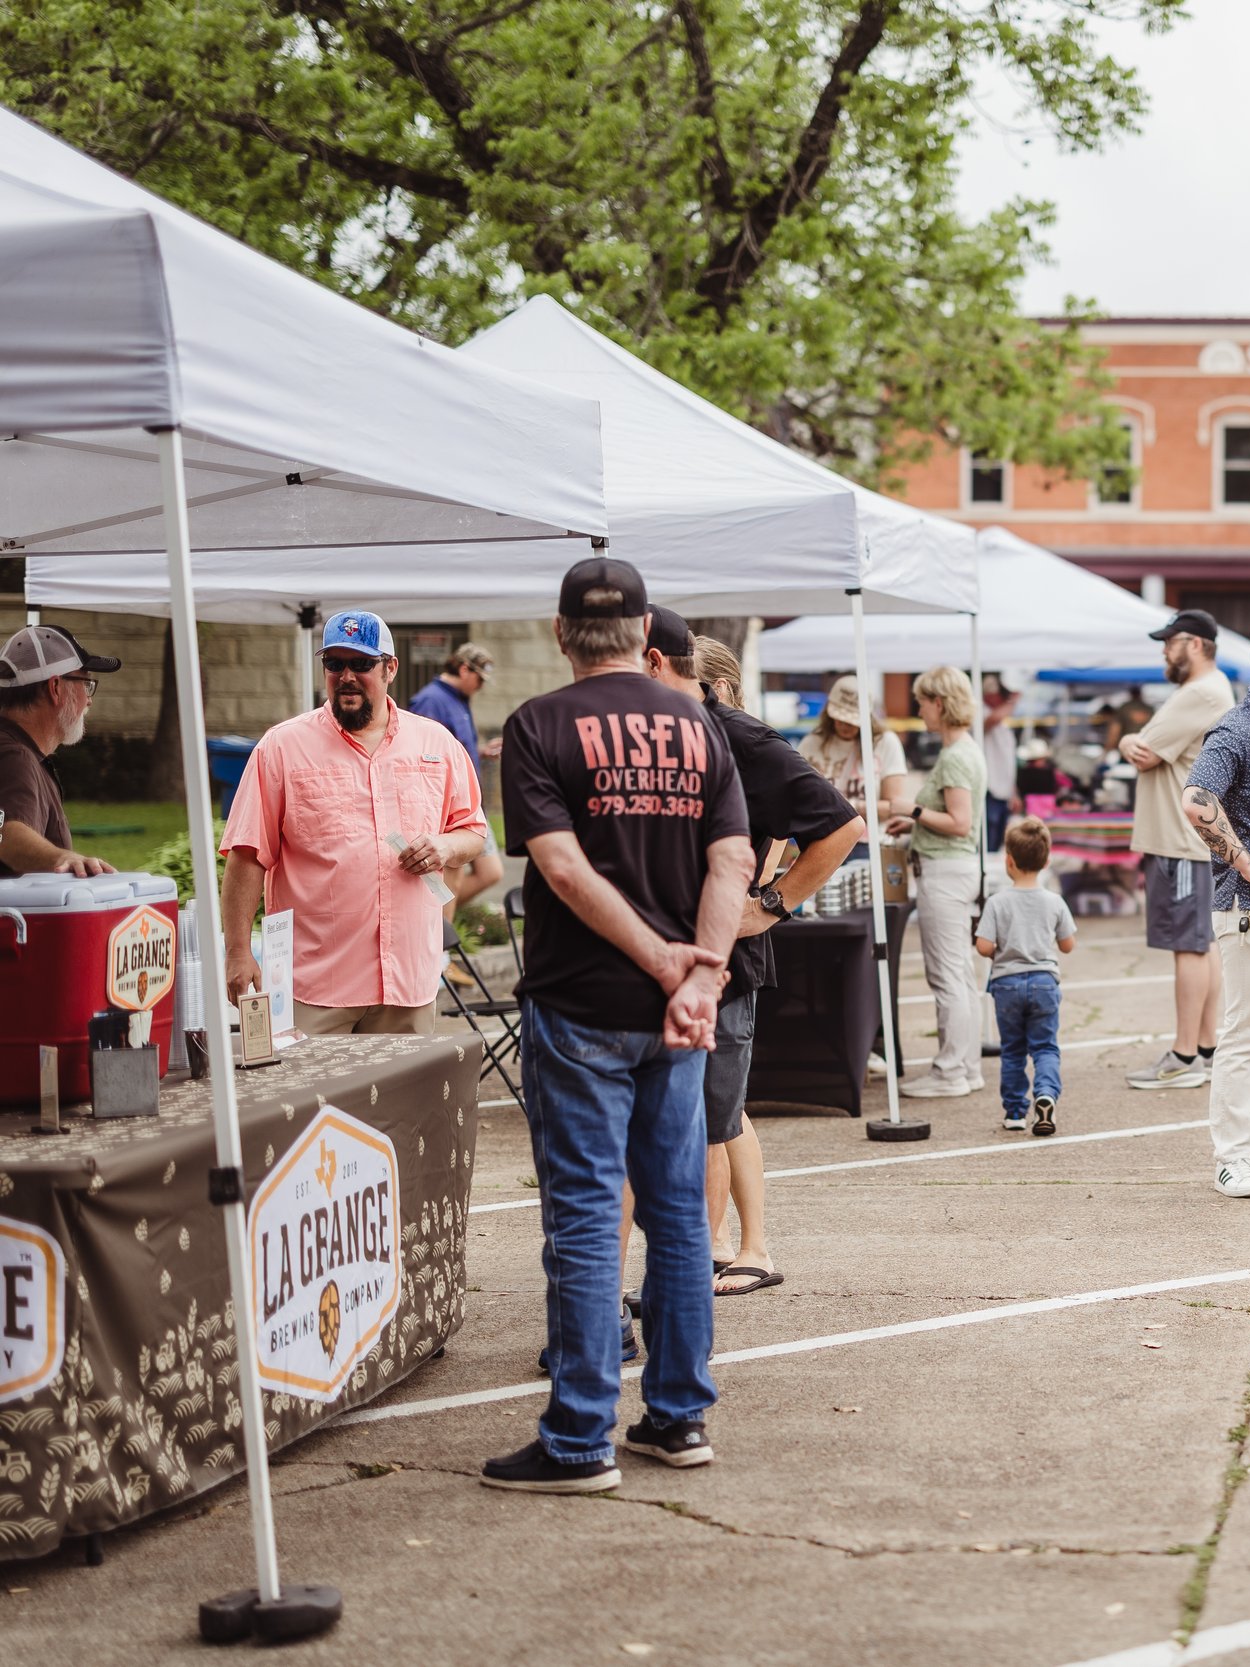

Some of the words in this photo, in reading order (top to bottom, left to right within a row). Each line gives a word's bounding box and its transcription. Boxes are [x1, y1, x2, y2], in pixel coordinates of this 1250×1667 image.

[575, 713, 706, 774] RISEN
[594, 769, 701, 794] OVERHEAD
[116, 945, 129, 980] LA
[131, 939, 171, 970] GRANGE
[295, 1180, 312, 1200] EST.
[342, 1160, 358, 1180] 2019
[262, 1223, 295, 1324] LA
[300, 1180, 391, 1288] GRANGE
[270, 1311, 314, 1352] BREWING
[344, 1275, 385, 1313] COMPANY
